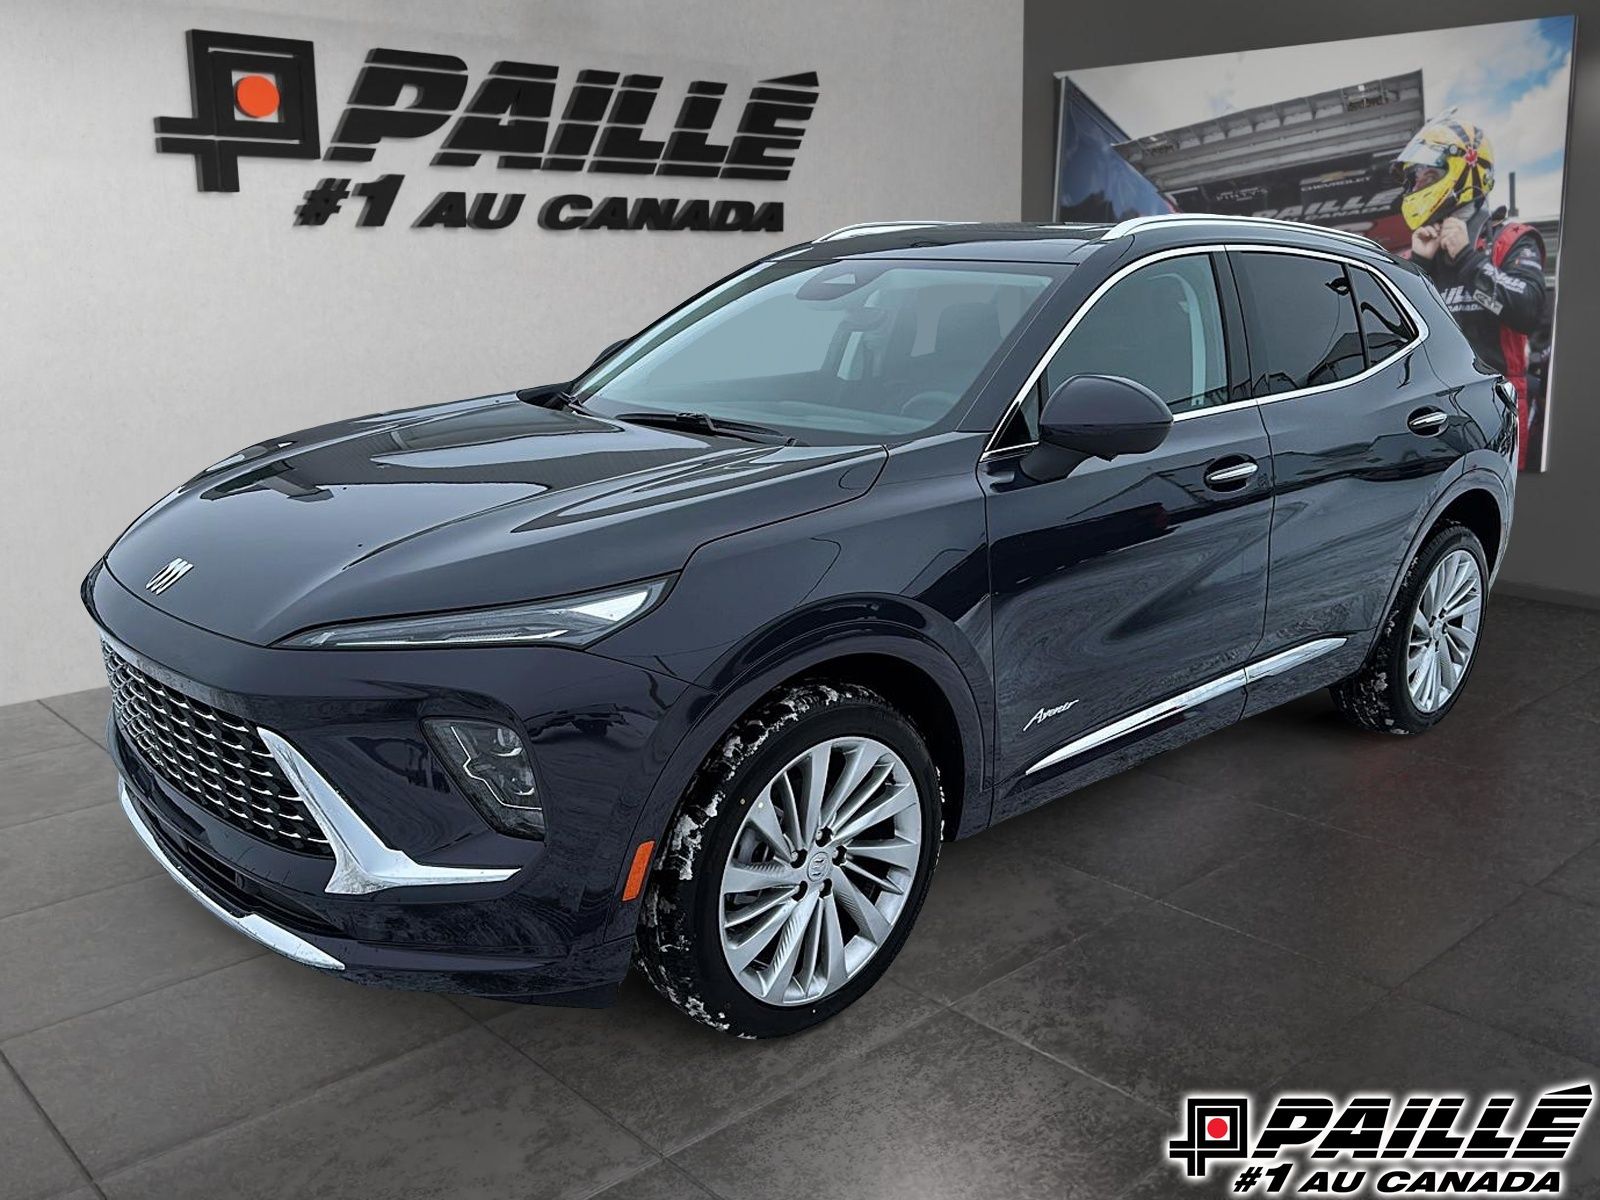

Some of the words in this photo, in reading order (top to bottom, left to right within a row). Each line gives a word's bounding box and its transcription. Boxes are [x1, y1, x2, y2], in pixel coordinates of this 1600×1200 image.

[322, 47, 820, 182] PAILLÉ
[292, 173, 406, 228] #1
[411, 191, 526, 230] AU
[535, 193, 785, 233] CANADA
